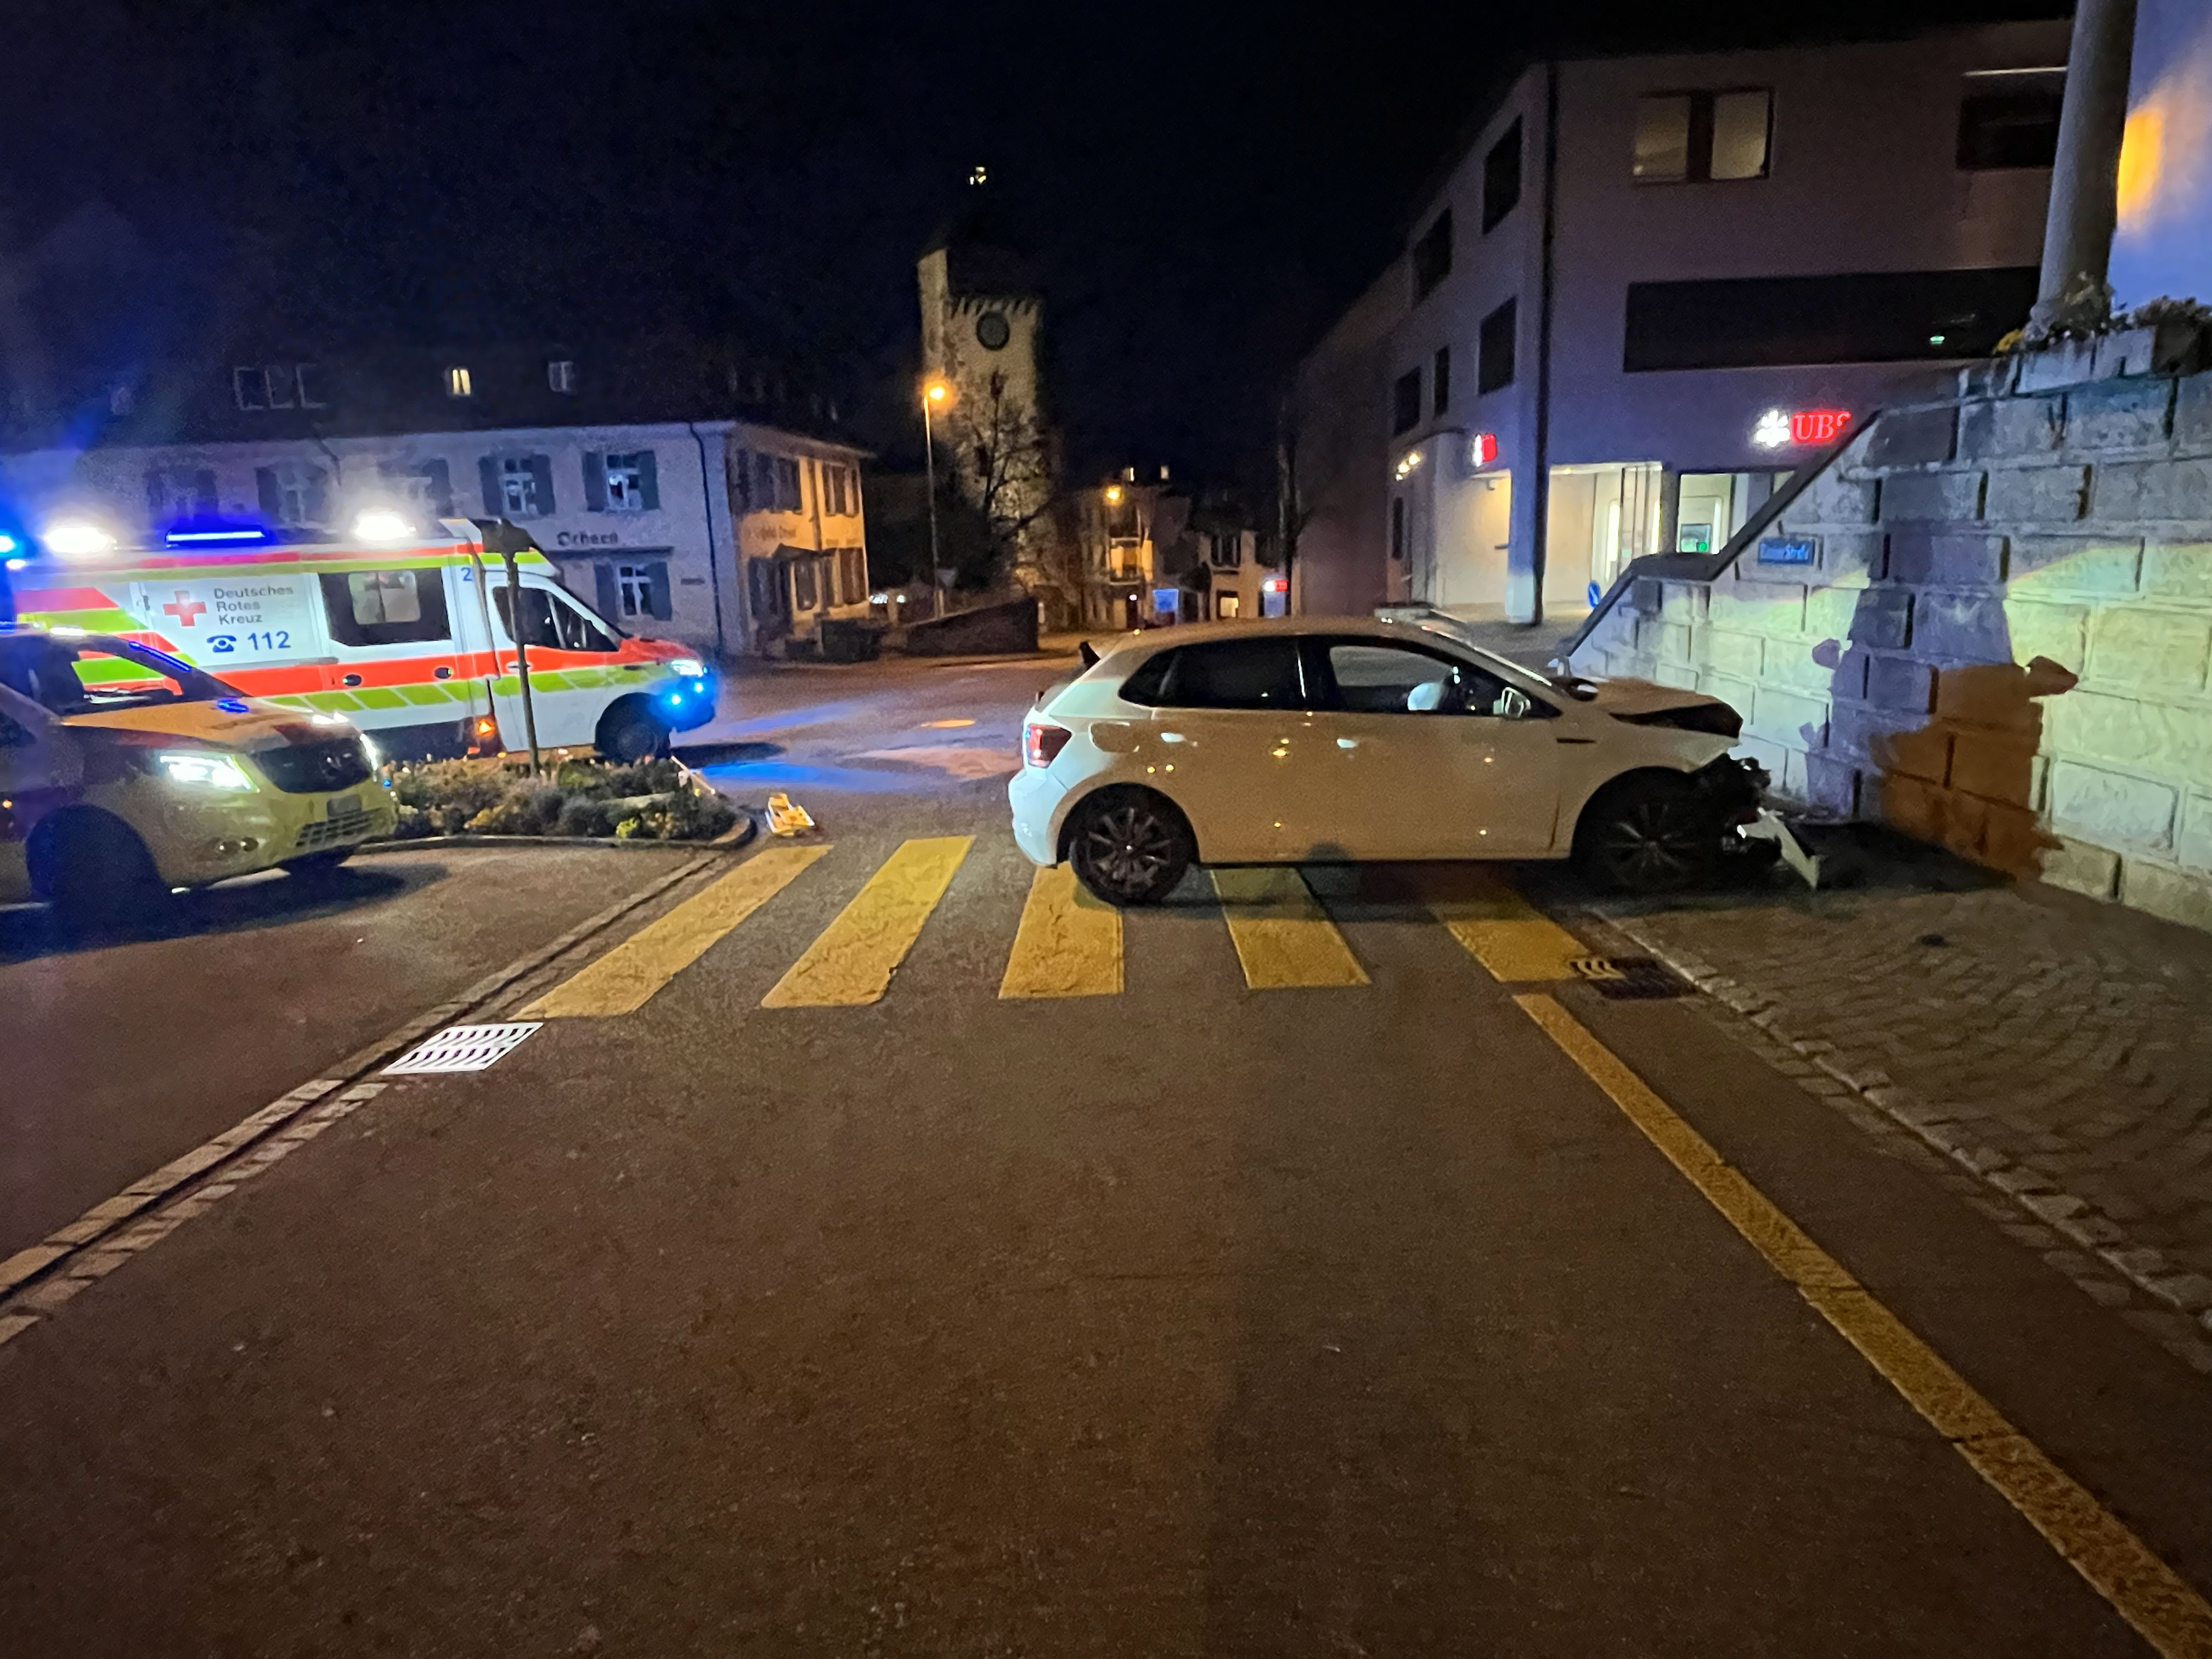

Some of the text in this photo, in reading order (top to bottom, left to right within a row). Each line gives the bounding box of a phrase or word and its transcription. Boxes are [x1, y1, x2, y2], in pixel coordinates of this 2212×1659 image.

[215, 585, 294, 599] Deutsches
[216, 601, 261, 612] Rotes
[219, 613, 263, 625] Kreuz
[247, 631, 292, 651] 112
